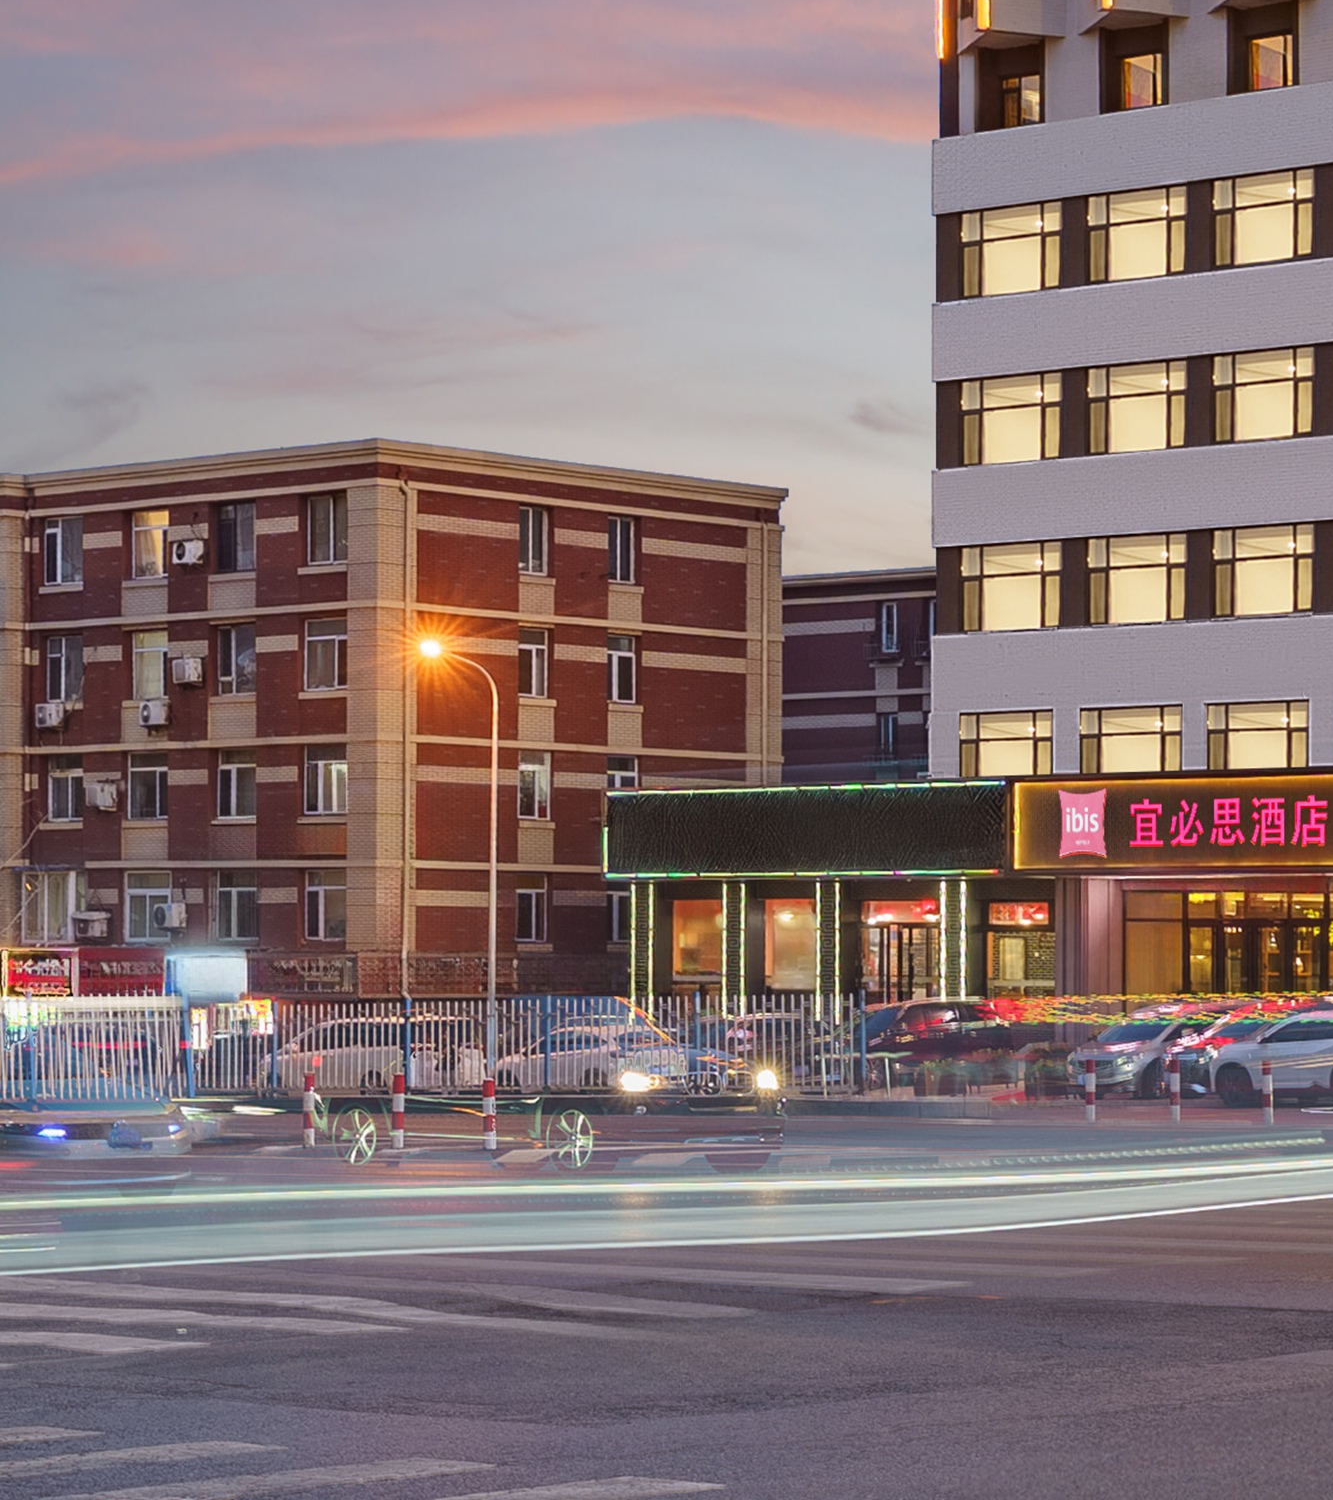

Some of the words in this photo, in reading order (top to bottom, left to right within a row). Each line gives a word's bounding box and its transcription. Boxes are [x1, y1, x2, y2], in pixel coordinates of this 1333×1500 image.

[1065, 807, 1099, 833] ibis
[1129, 795, 1329, 848] 宜必思酒店
